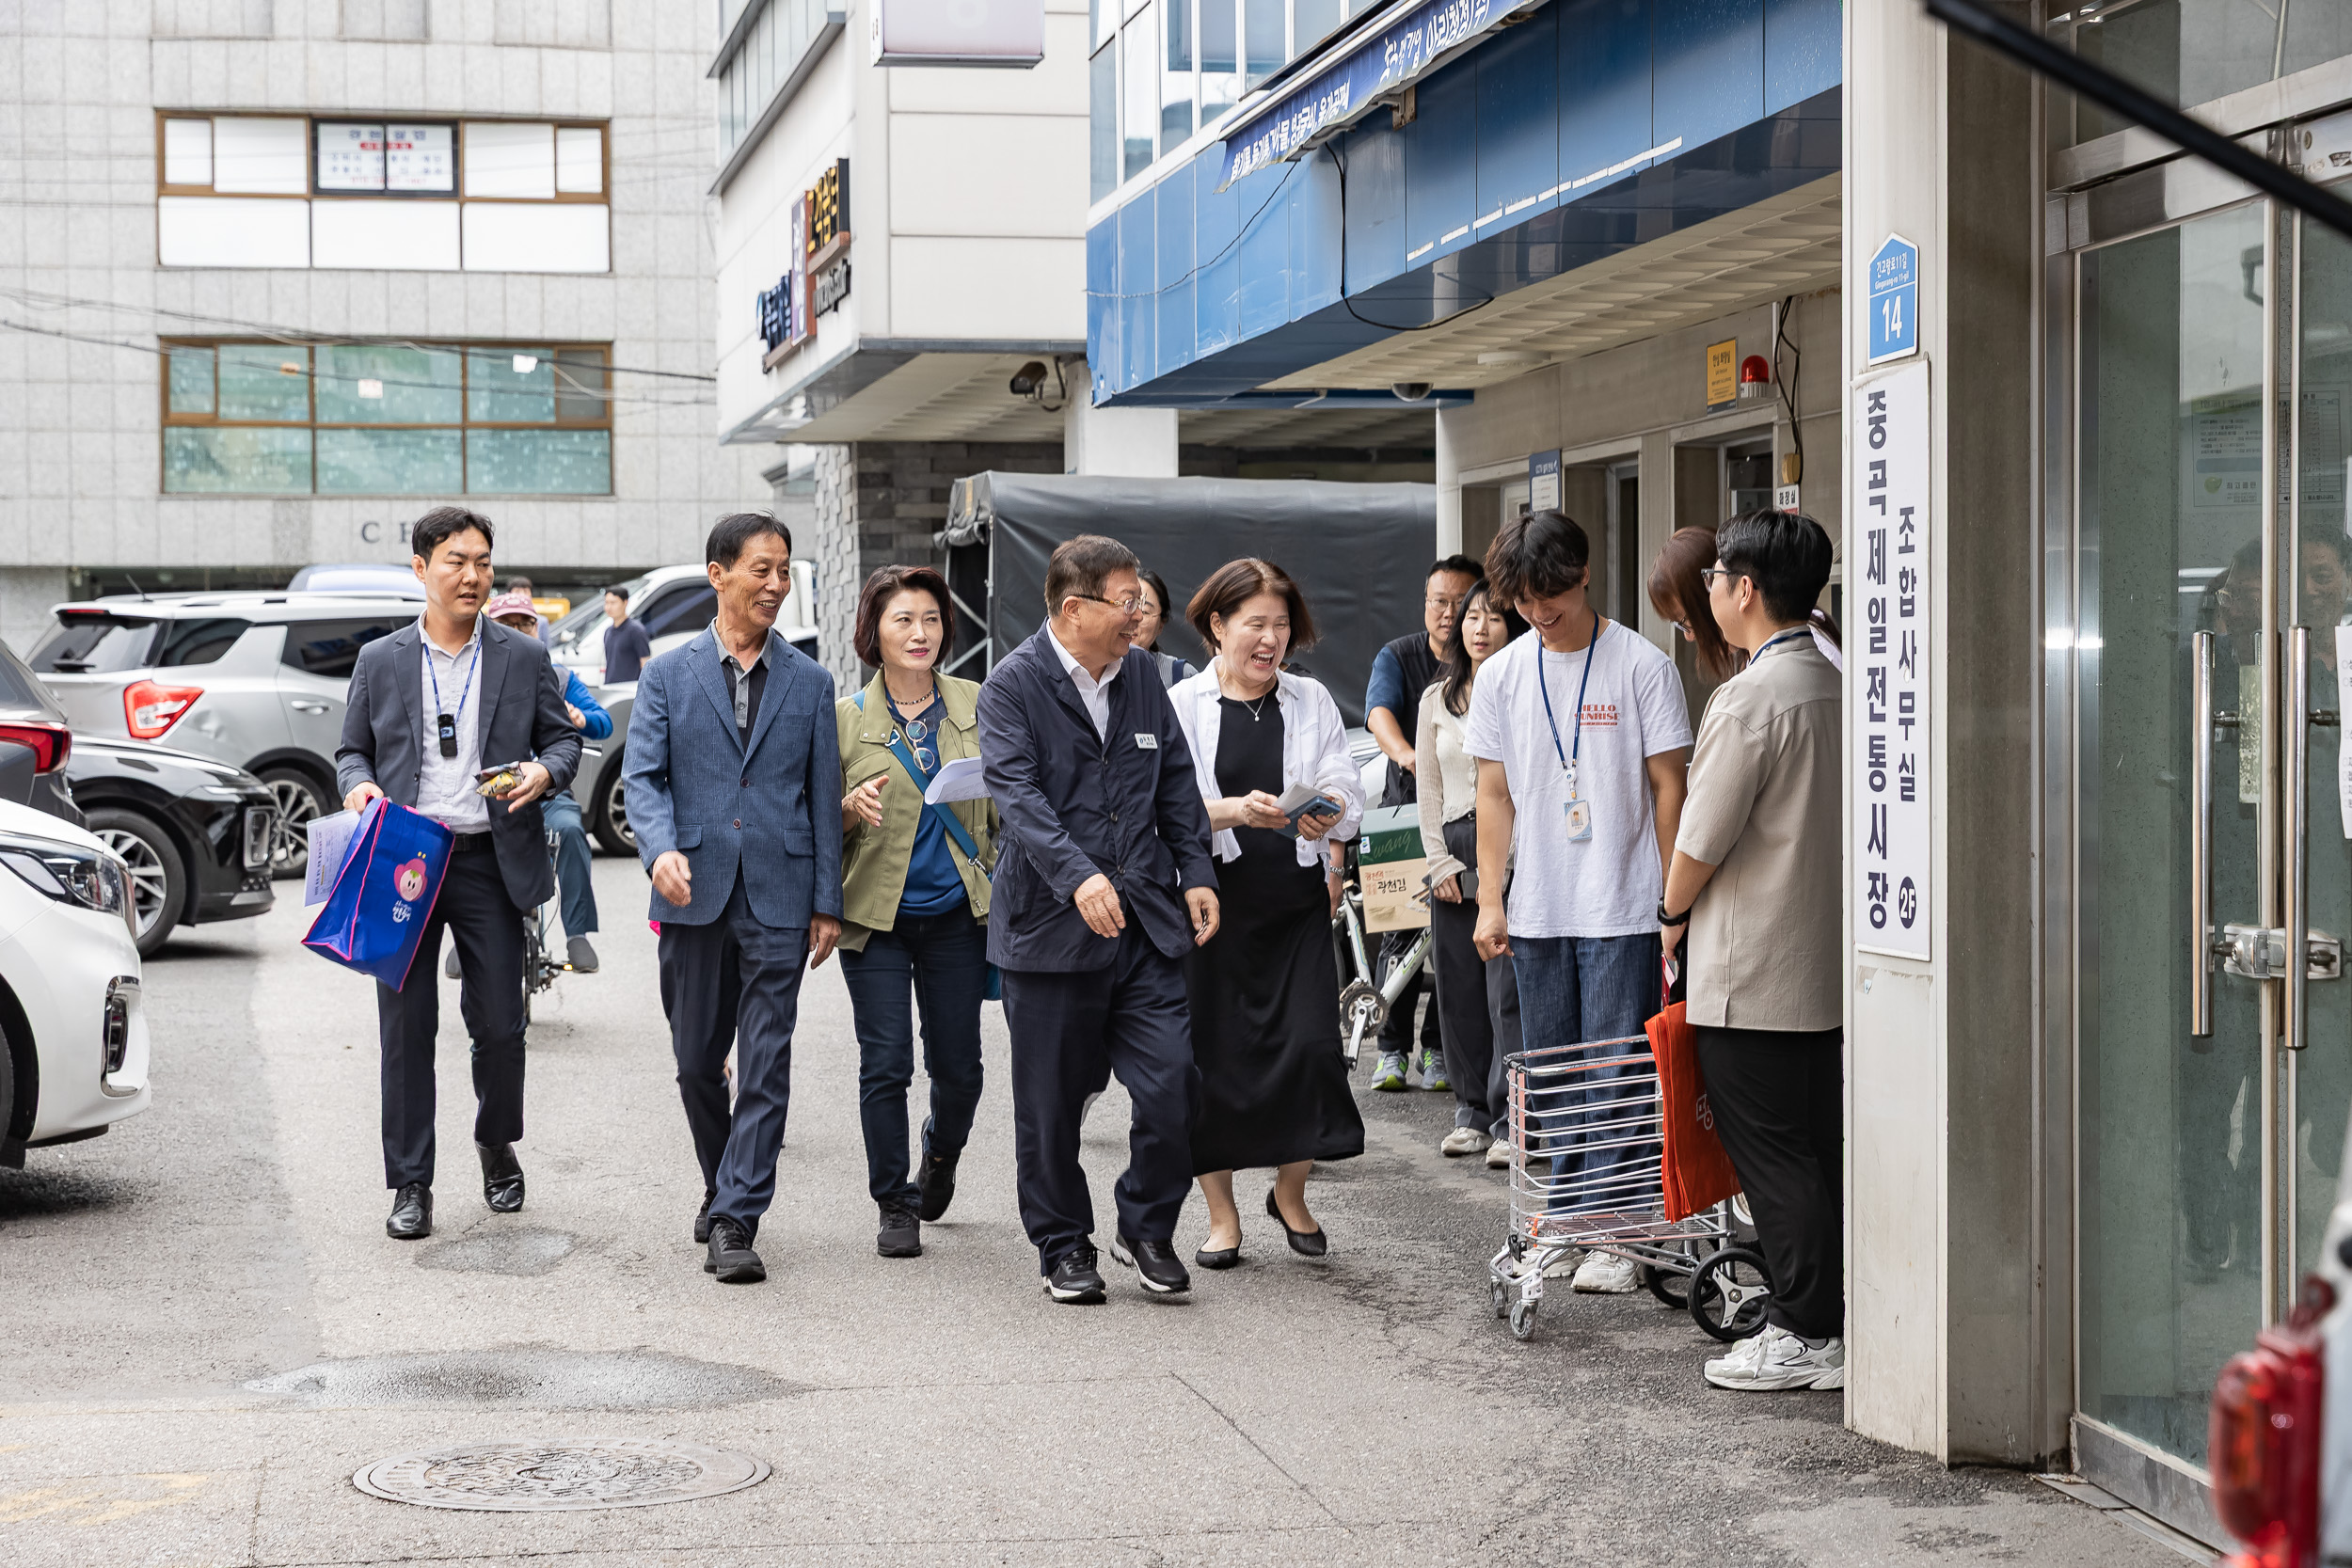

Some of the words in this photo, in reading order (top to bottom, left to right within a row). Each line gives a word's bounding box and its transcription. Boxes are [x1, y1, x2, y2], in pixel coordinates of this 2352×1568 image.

[1876, 251, 1908, 278] 긴고랑로11길
[1874, 273, 1899, 291] Gingorang-ro
[1883, 294, 1902, 342] 14
[1778, 489, 1796, 506] 화장실
[1867, 389, 1889, 929] 중곡제일전통시장
[1898, 506, 1917, 802] 조합사무실
[1377, 878, 1406, 895] 광천김
[1899, 887, 1915, 919] 2F
